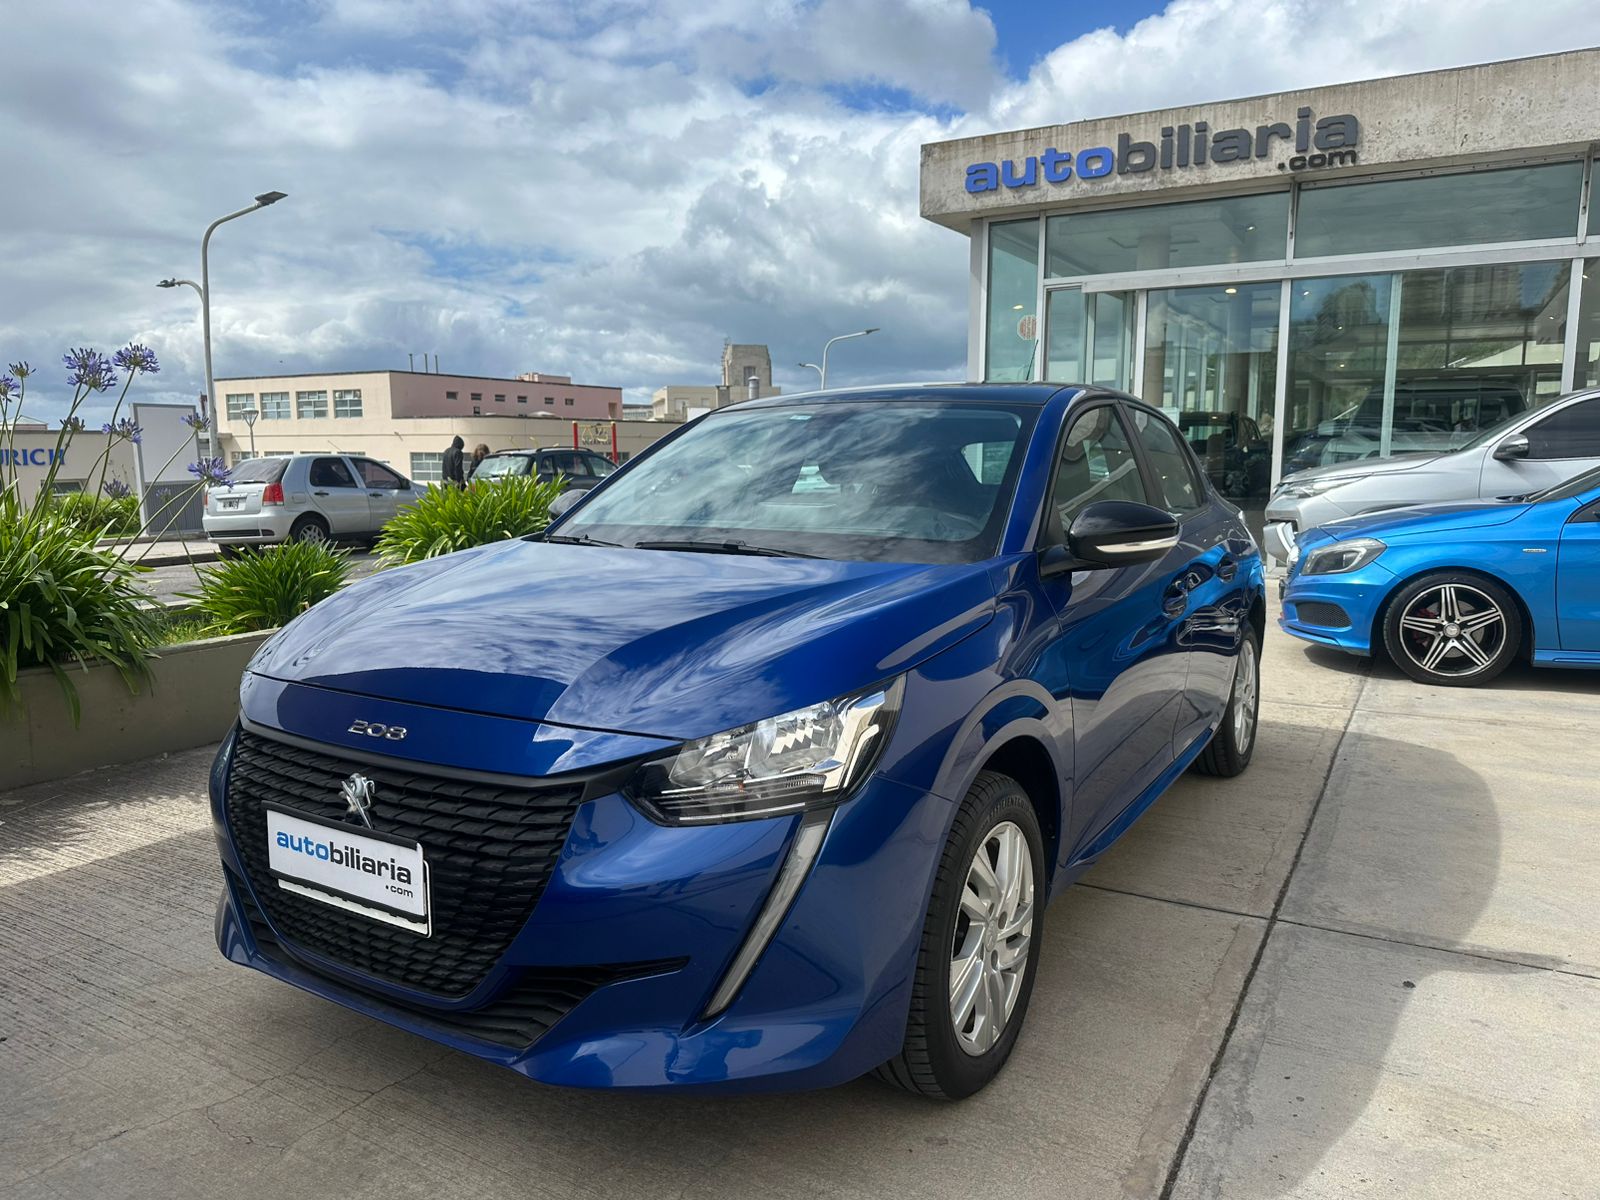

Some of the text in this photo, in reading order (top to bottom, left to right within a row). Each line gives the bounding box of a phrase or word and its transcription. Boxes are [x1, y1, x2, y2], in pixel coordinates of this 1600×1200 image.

[965, 106, 1359, 194] autobiliaria
[1277, 148, 1358, 171] .com
[347, 719, 408, 741] 208
[276, 830, 412, 885] autobiliaria
[385, 884, 414, 899] .com
